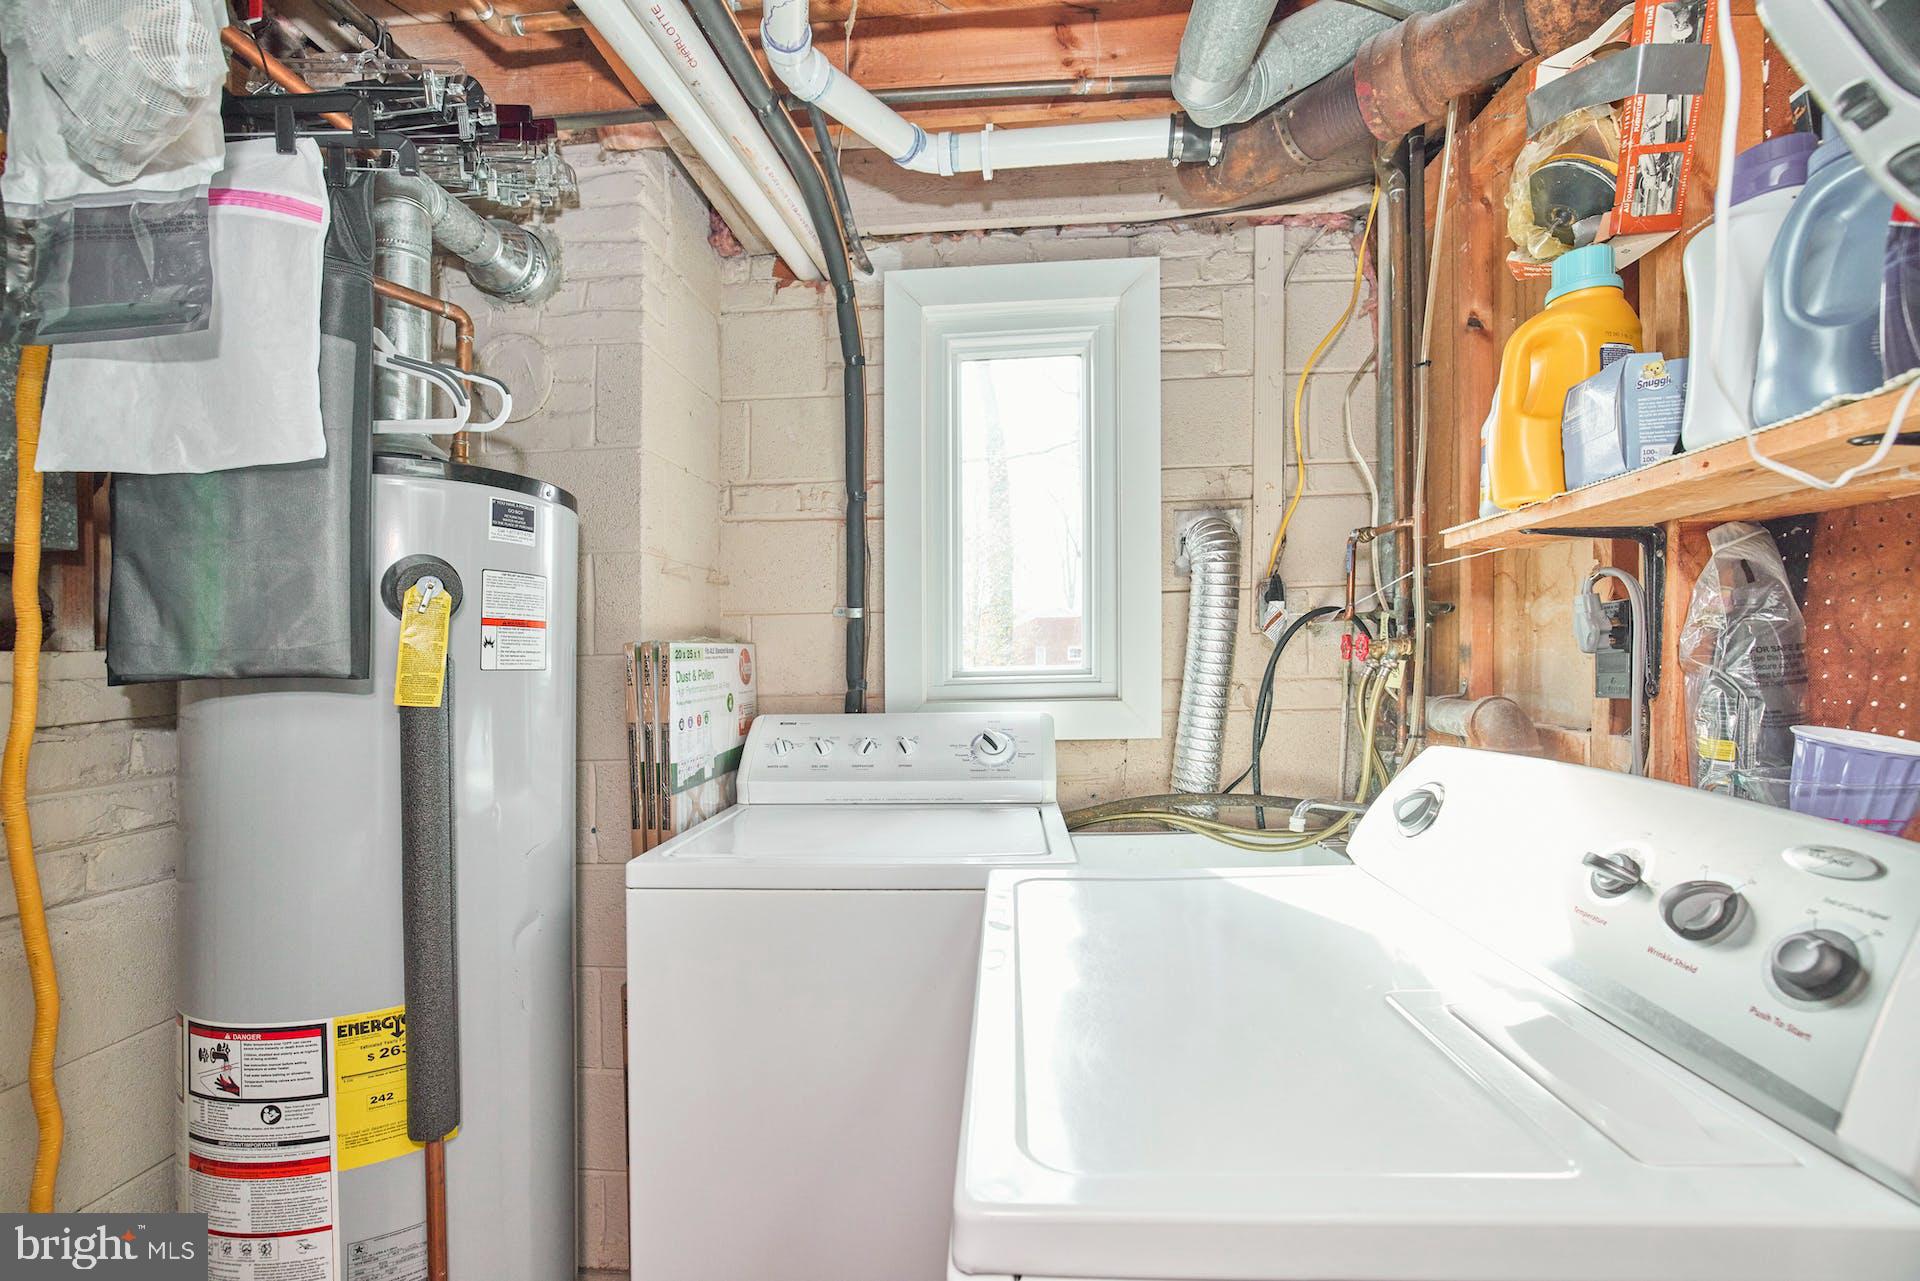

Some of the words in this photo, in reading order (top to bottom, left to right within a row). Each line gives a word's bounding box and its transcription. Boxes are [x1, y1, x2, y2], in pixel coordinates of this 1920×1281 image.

[1646, 4, 1656, 26] ITEMS
[650, 4, 698, 69] CHARLOTTE
[1622, 165, 1636, 214] AUTOMOBILES
[674, 649, 683, 660] 20
[675, 670, 692, 684] Dust
[698, 669, 715, 682] Pollen
[1573, 905, 1608, 926] Temperature
[1647, 945, 1675, 963] Wrinkle
[1673, 957, 1698, 975] Shield
[1749, 1005, 1772, 1022] Push
[1774, 1016, 1786, 1028] To
[1786, 1023, 1812, 1041] Start
[232, 1033, 262, 1041] DANGER
[367, 1052, 375, 1062] $
[370, 1092, 394, 1105] 242
